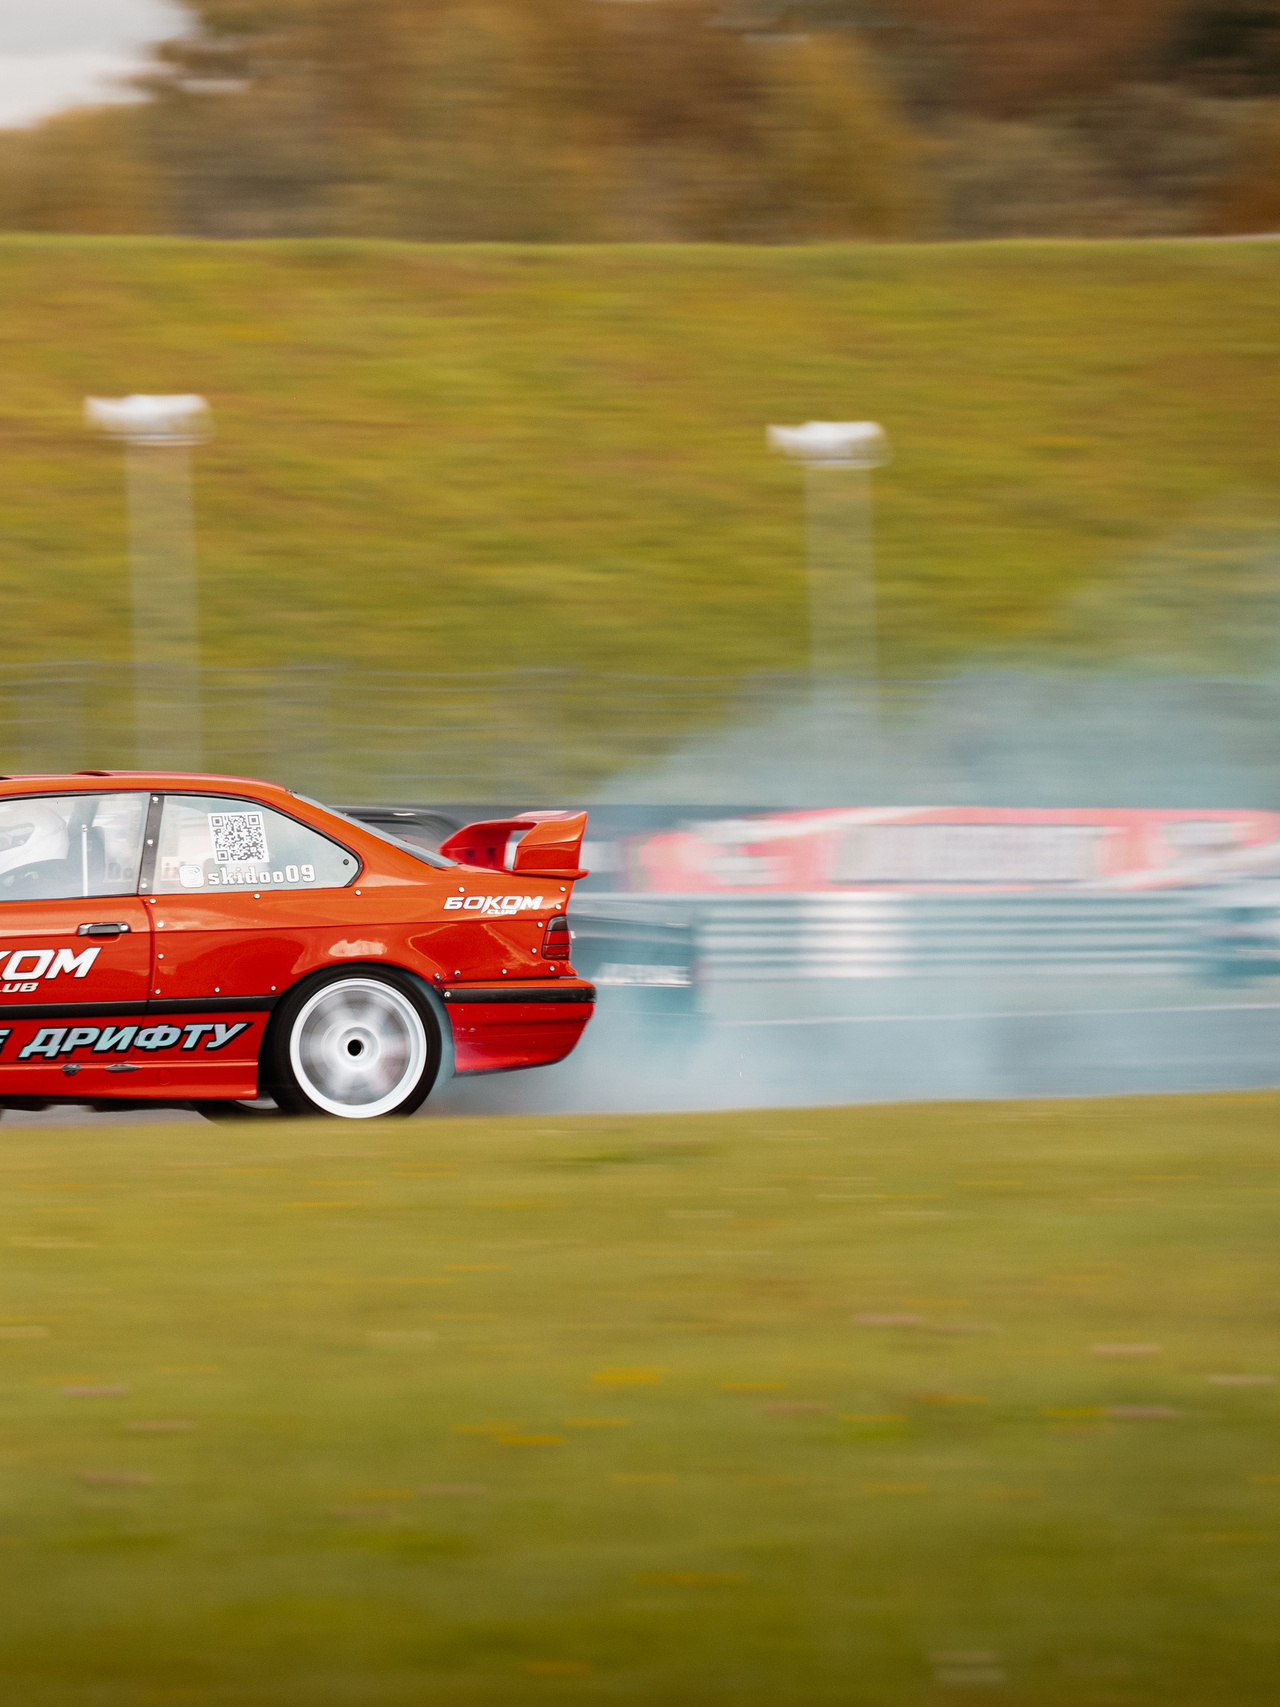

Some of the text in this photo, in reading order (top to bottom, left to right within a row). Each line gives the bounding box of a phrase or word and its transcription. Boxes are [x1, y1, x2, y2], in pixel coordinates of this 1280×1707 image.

[208, 864, 316, 885] skidoo09
[443, 896, 544, 914] БОКОМ
[18, 1022, 253, 1060] ДРИФТУ
